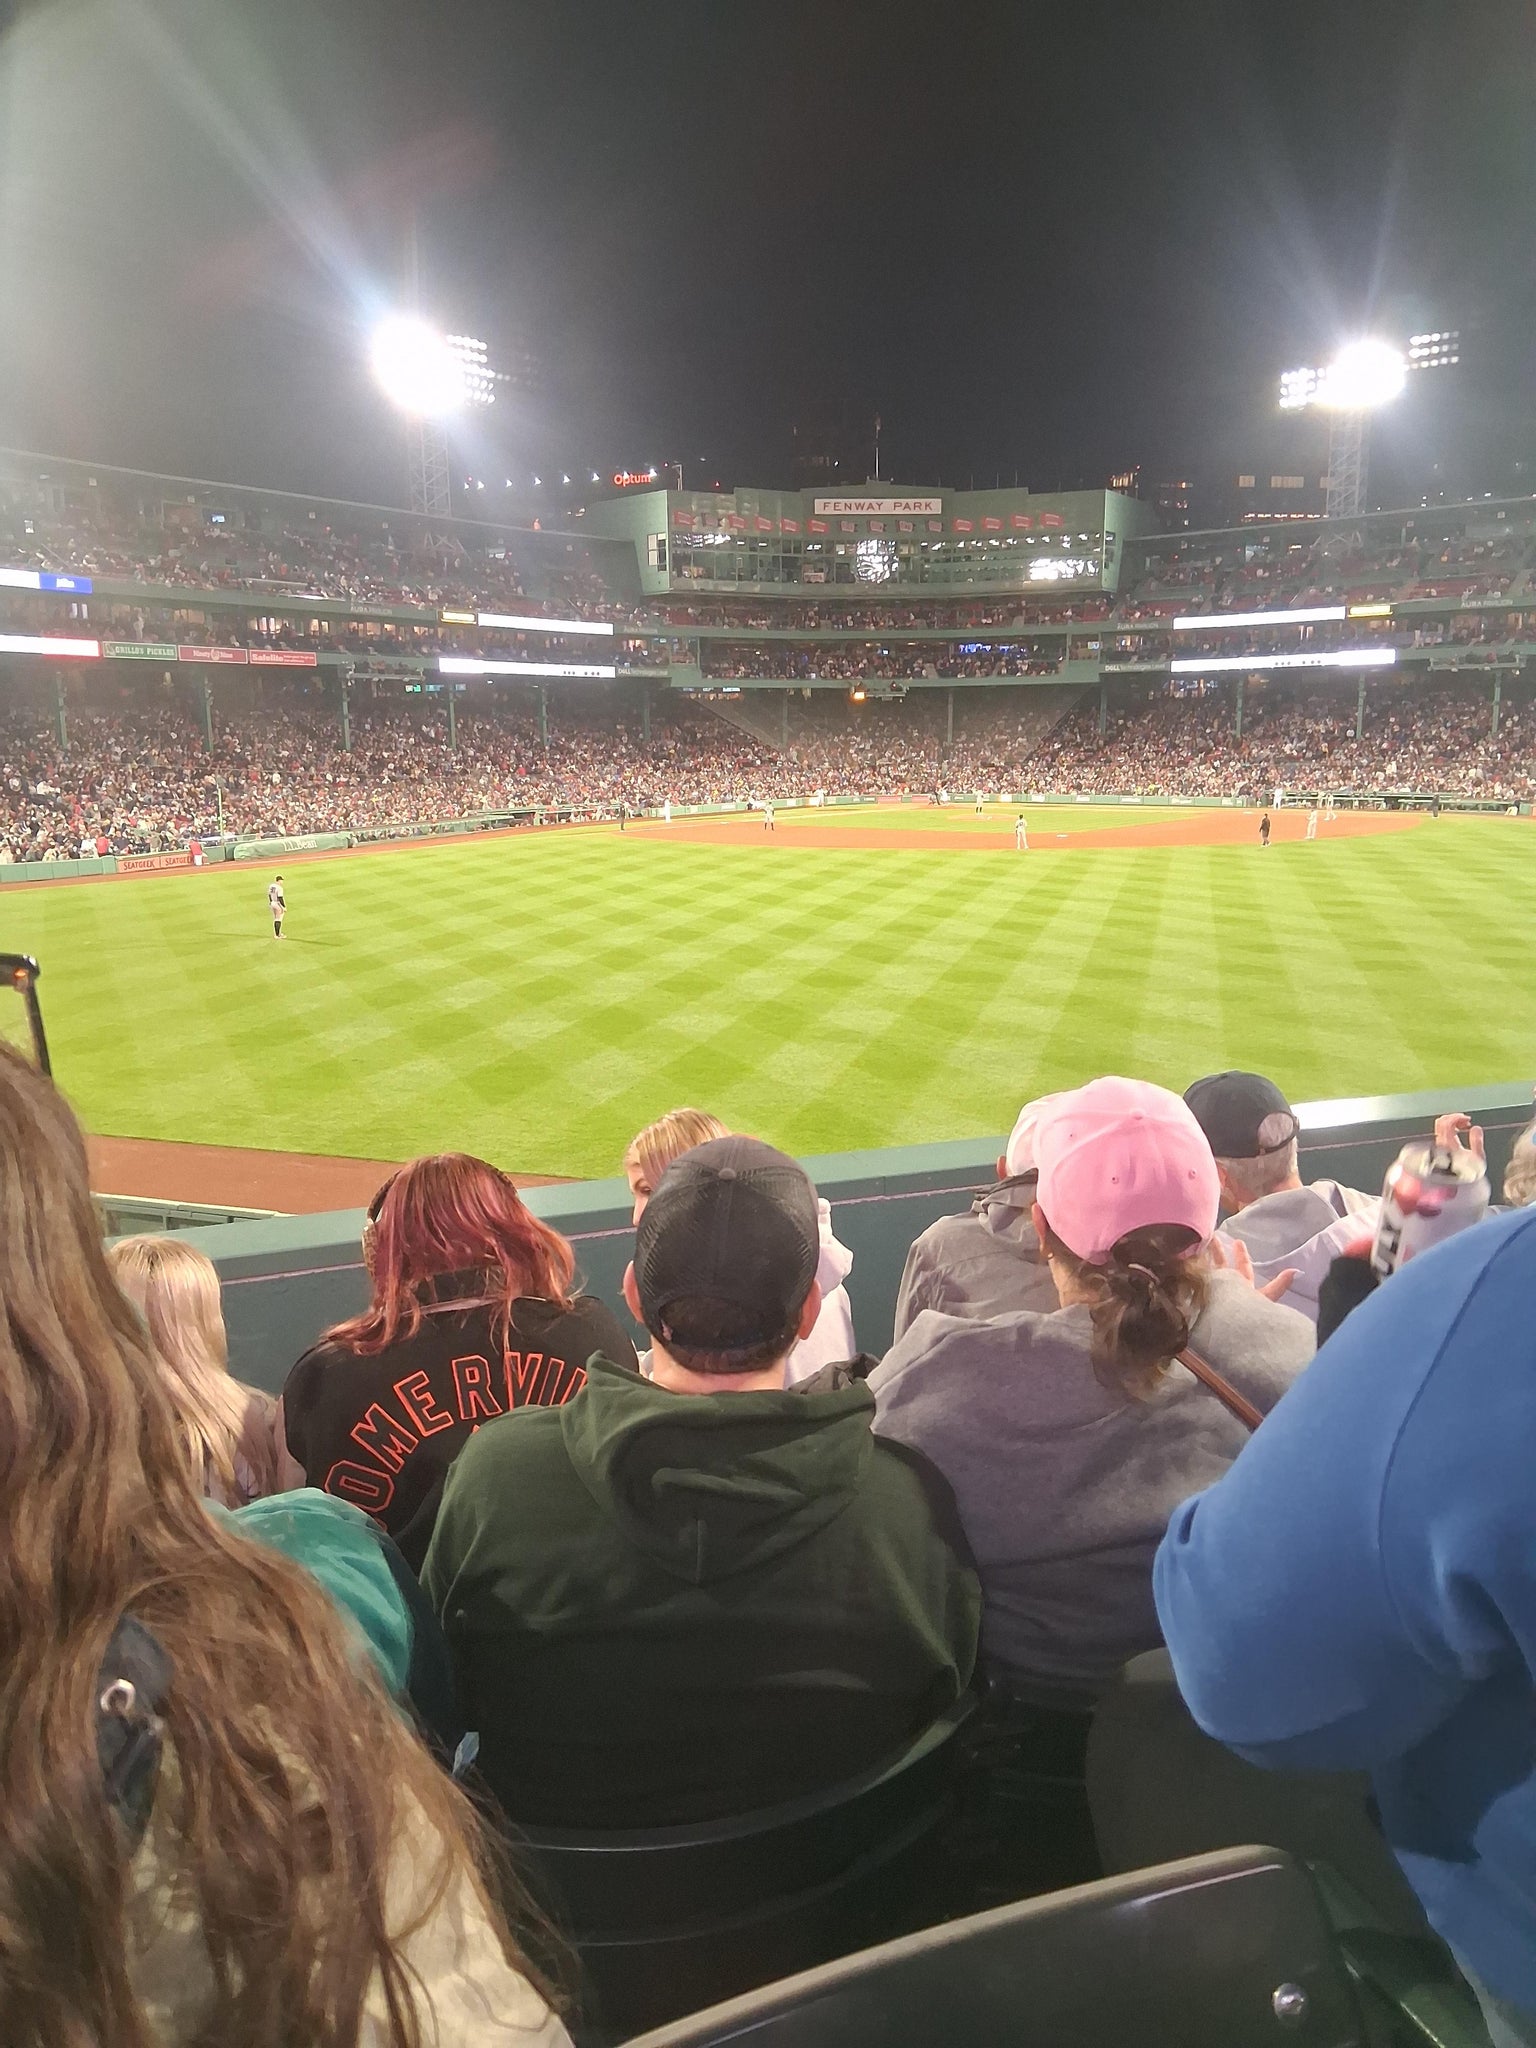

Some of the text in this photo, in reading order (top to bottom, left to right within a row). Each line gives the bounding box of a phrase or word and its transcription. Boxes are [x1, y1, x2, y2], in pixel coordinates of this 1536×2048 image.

[614, 473, 652, 487] Optum
[823, 501, 933, 511] FENWAY PARK
[146, 647, 175, 656] PICKLES
[252, 653, 284, 663] Safelite
[123, 855, 193, 871] SEATGEEK SEATGEE
